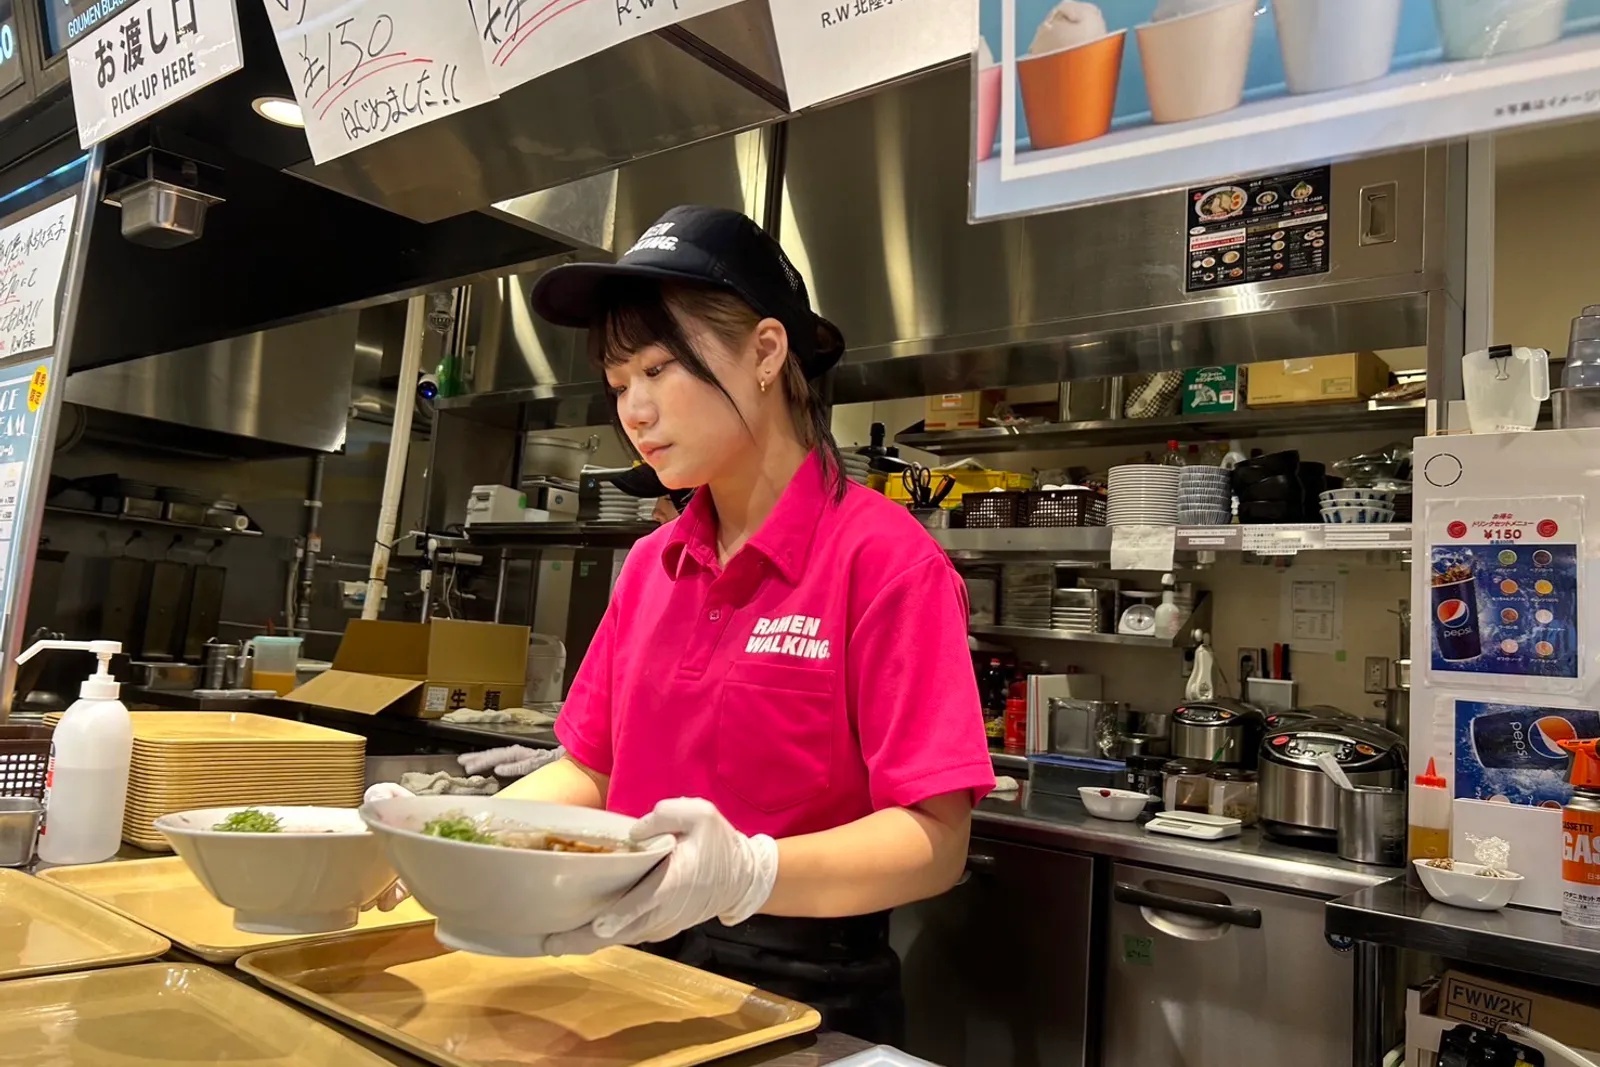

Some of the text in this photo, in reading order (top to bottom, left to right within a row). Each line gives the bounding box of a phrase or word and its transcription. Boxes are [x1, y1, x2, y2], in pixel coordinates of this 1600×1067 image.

[68, 2, 102, 38] GOUMEN
[94, 0, 199, 89] お渡し口
[111, 52, 197, 118] PICK-UP HERE
[1484, 529, 1522, 540] ¥150
[752, 614, 822, 638] RAMEN
[1509, 721, 1532, 759] pepsi
[1453, 985, 1525, 1019] FWW2K
